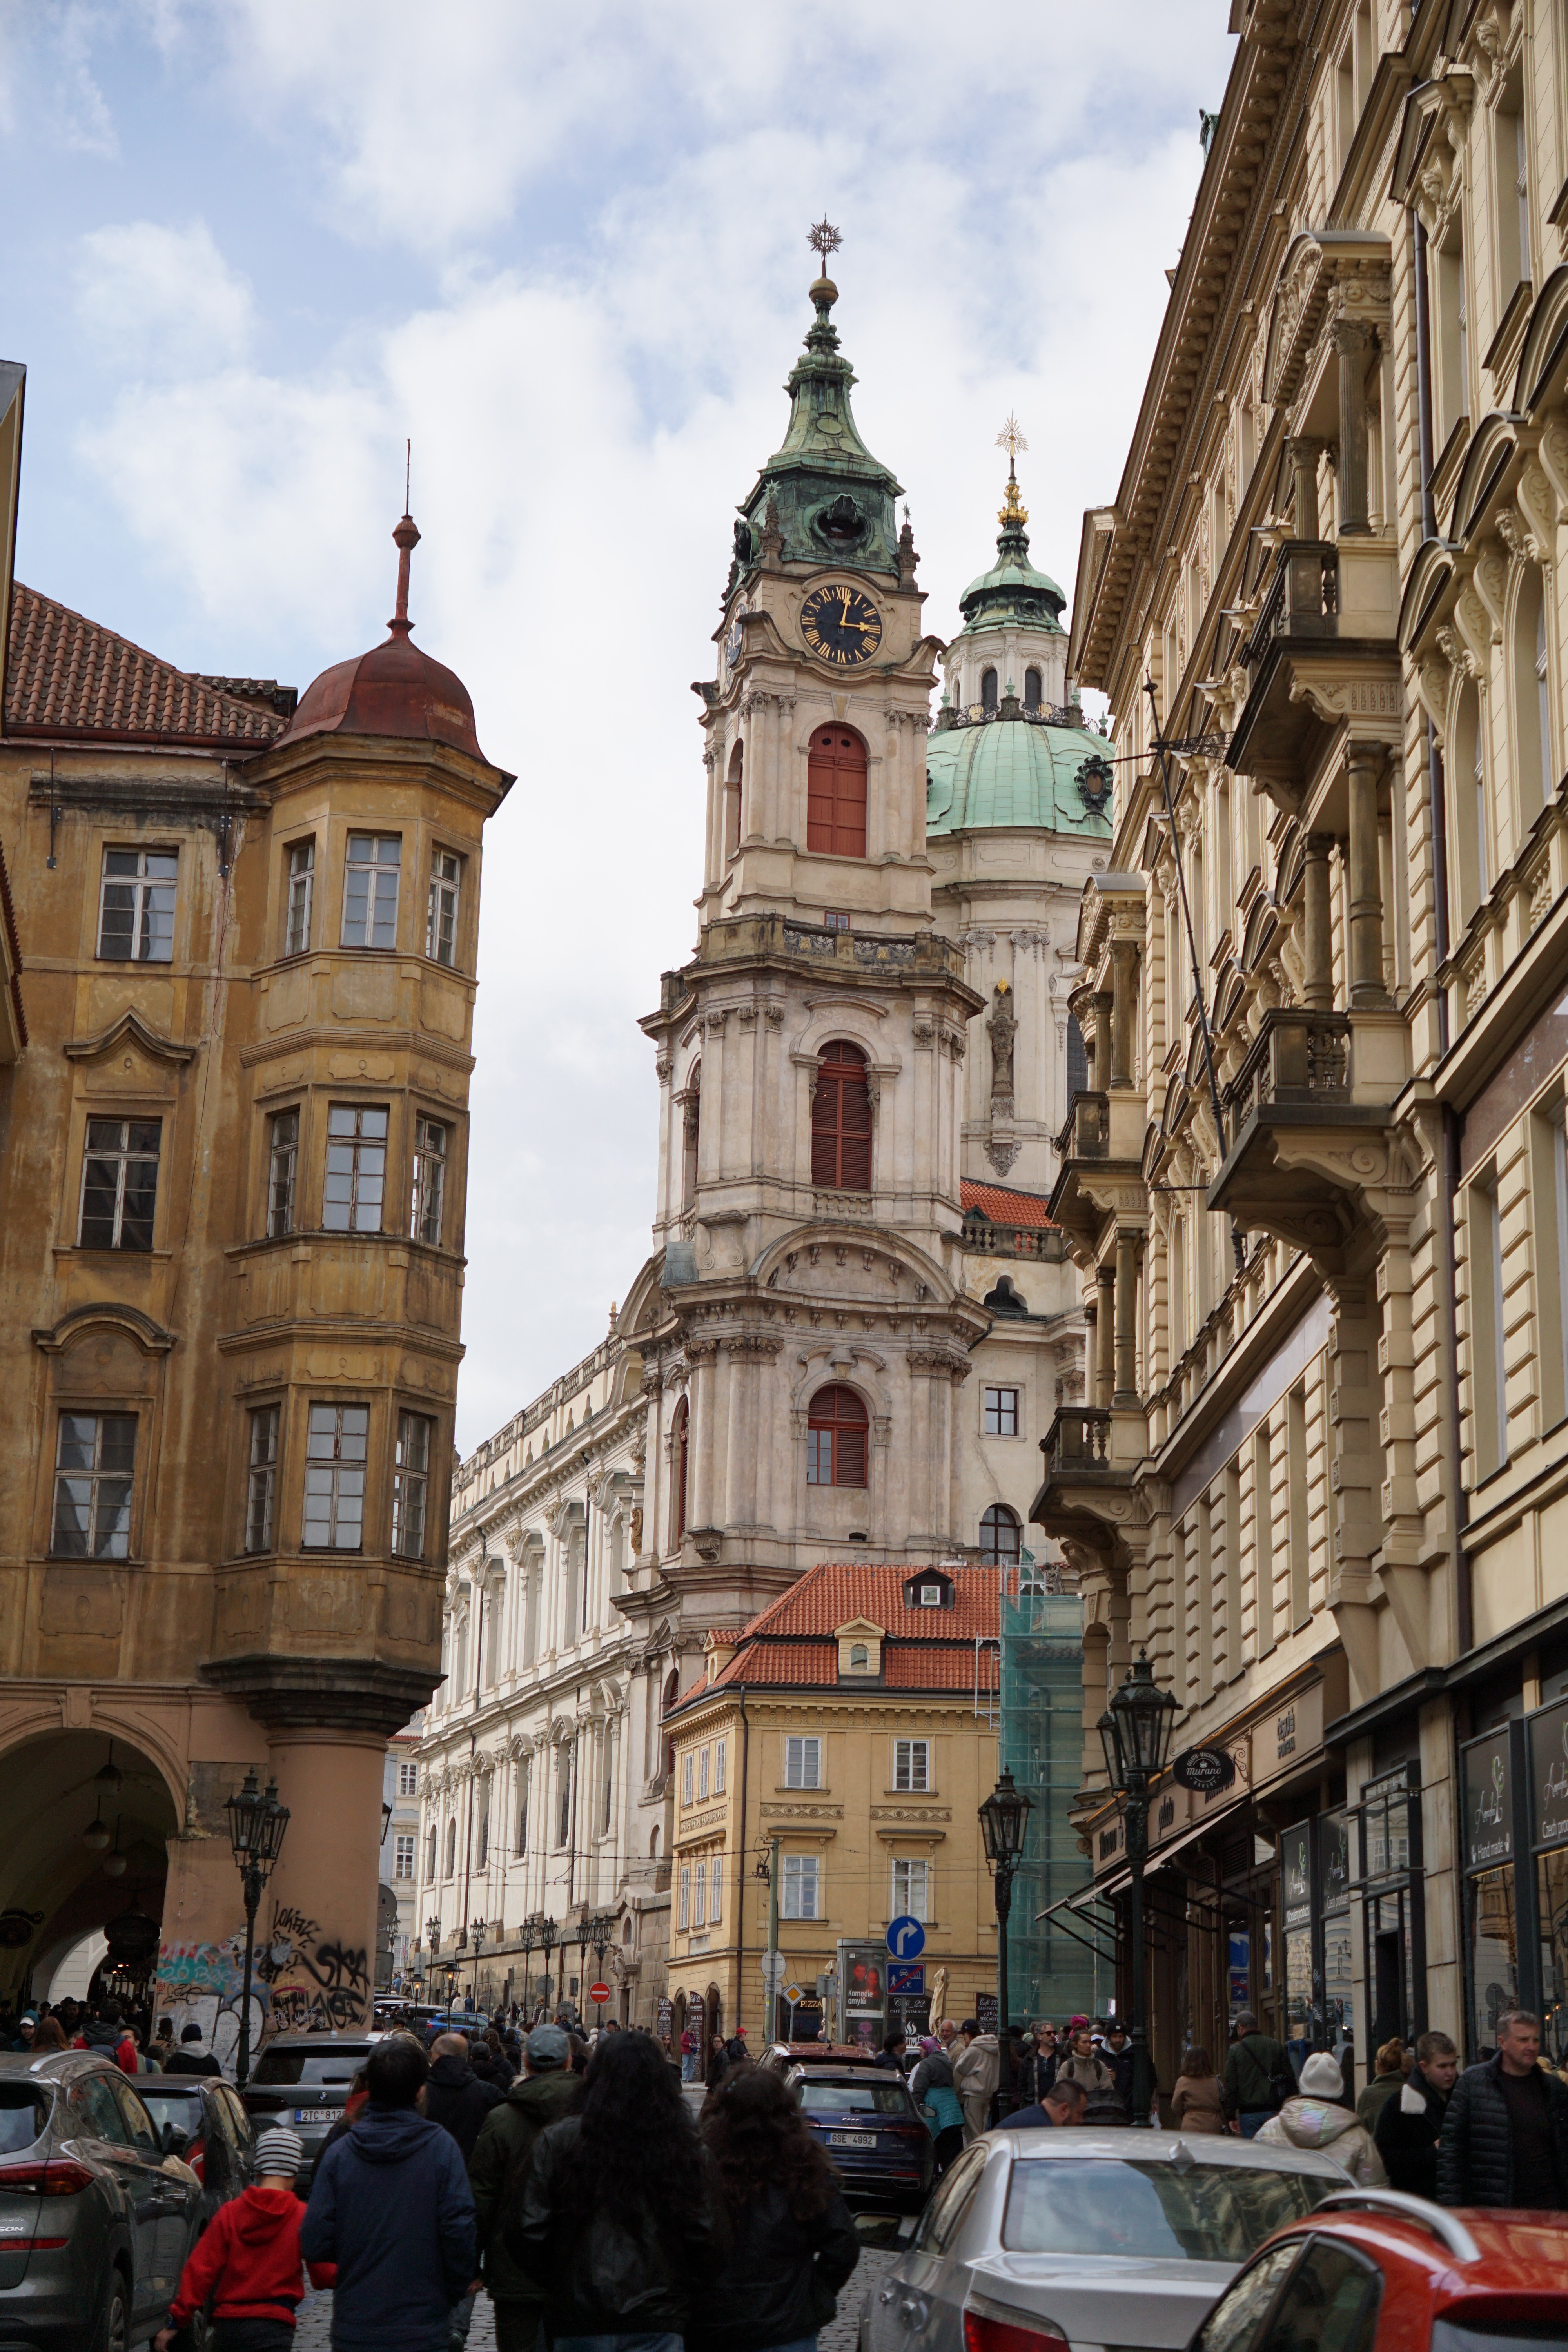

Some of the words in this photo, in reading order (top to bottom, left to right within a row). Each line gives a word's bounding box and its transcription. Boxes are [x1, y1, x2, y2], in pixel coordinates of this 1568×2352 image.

[818, 588, 832, 603] XI
[854, 593, 862, 606] I
[806, 599, 821, 612] X
[863, 608, 877, 617] II
[802, 615, 816, 626] IX
[804, 629, 821, 646] VIII
[817, 642, 831, 659] VII
[837, 649, 846, 664] VI
[854, 648, 864, 662] V
[1193, 1780, 1217, 1788] BAKERY
[1542, 1818, 1557, 1838] Czech
[848, 1997, 866, 2006] omylů
[303, 2111, 319, 2120] 2TC
[832, 2134, 847, 2143] 6SE
[853, 2136, 872, 2145] 4992
